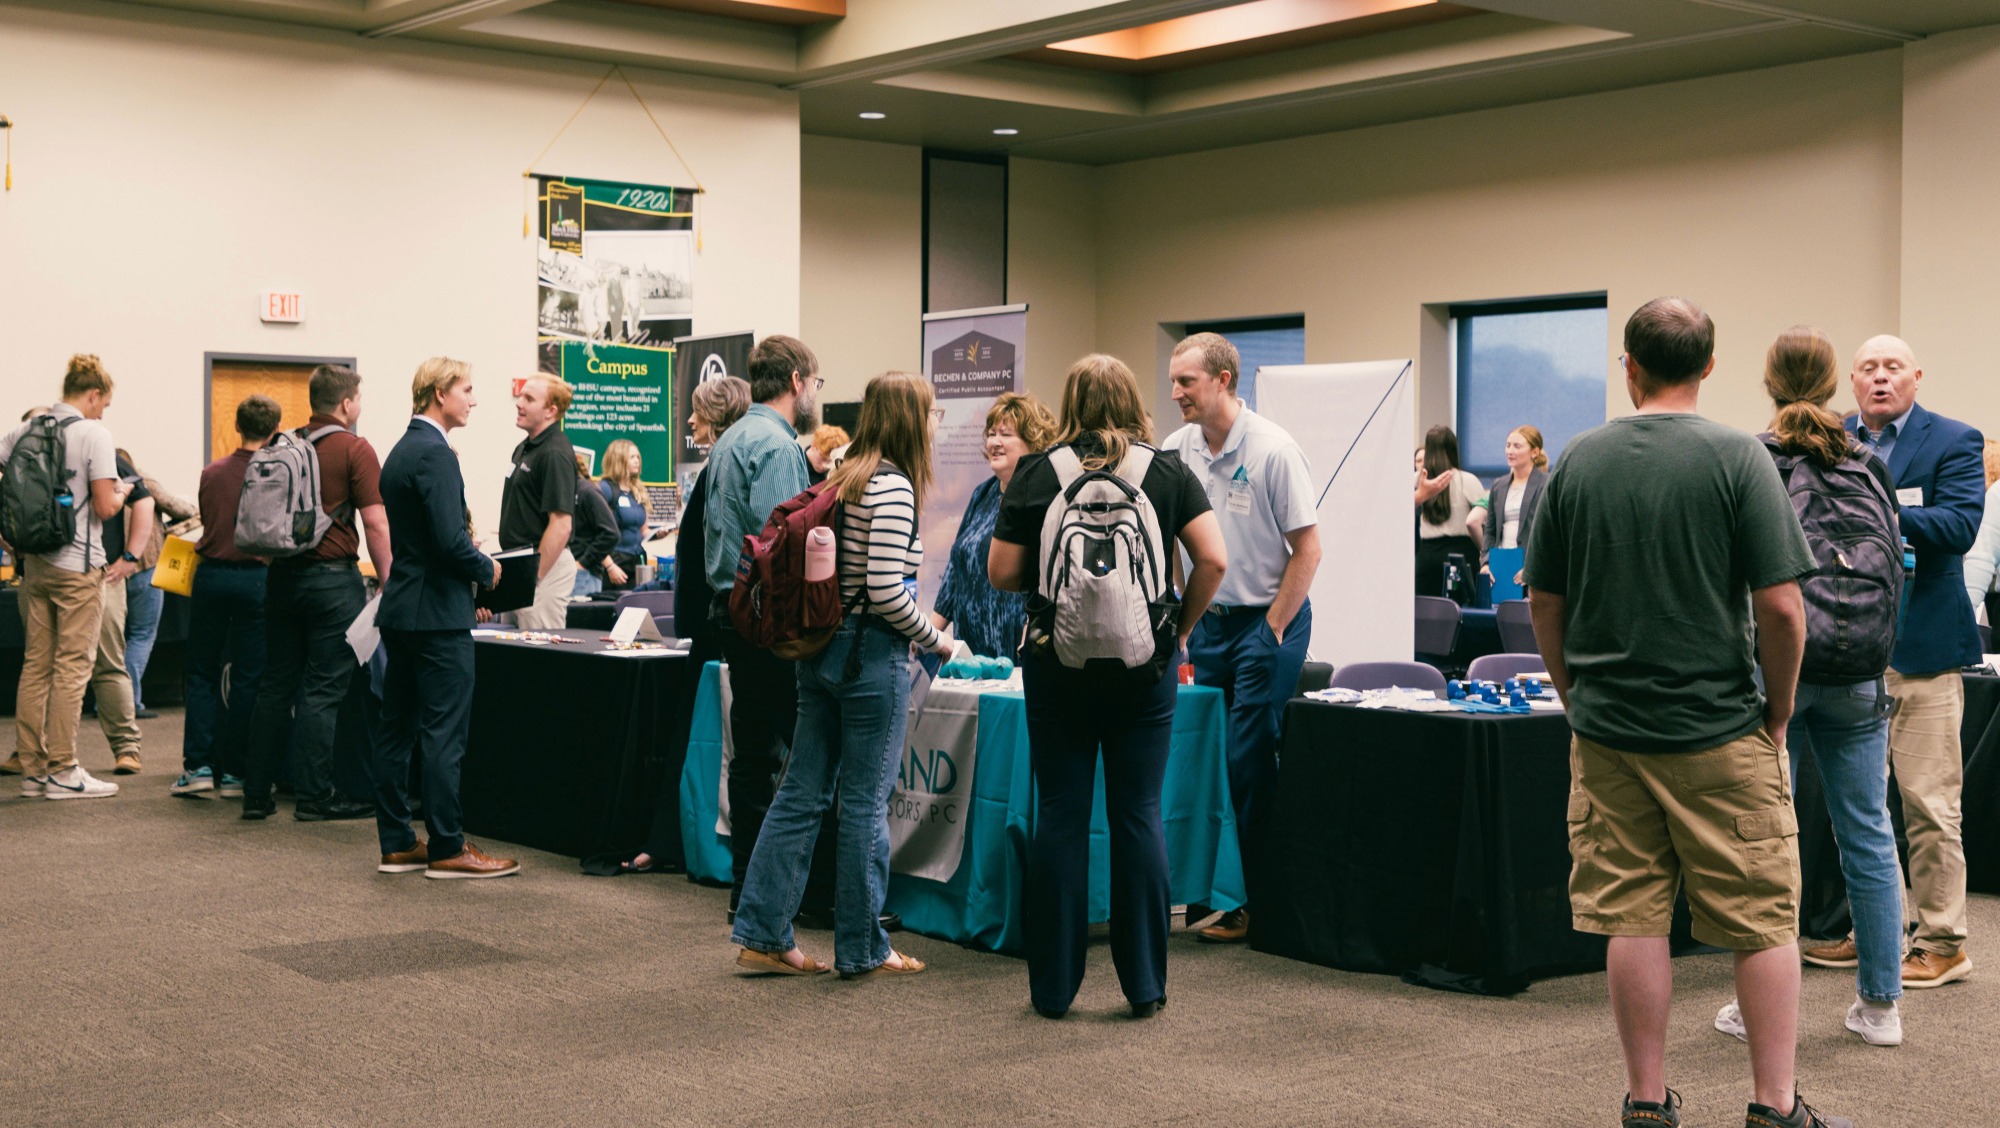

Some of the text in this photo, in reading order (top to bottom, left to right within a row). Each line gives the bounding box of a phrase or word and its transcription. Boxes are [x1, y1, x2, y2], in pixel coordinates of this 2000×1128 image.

[615, 188, 669, 210] 1920s
[269, 292, 300, 318] EXIT
[587, 358, 648, 379] Campus
[934, 369, 1012, 383] BECHEN & COMPANY PC
[578, 382, 599, 392] BHSU
[600, 384, 627, 394] campus,
[628, 386, 661, 395] recognized
[977, 385, 1006, 393] Accountant
[586, 393, 594, 401] of
[594, 393, 605, 401] the
[606, 394, 622, 402] most
[623, 394, 650, 403] beautiful
[577, 403, 598, 412] region,
[616, 404, 642, 412] includes
[565, 411, 595, 421] buildings
[606, 412, 618, 421] 123
[564, 422, 667, 433] overlooking the city of Spearfish.
[897, 745, 958, 794] AND
[886, 798, 924, 826] SORS,
